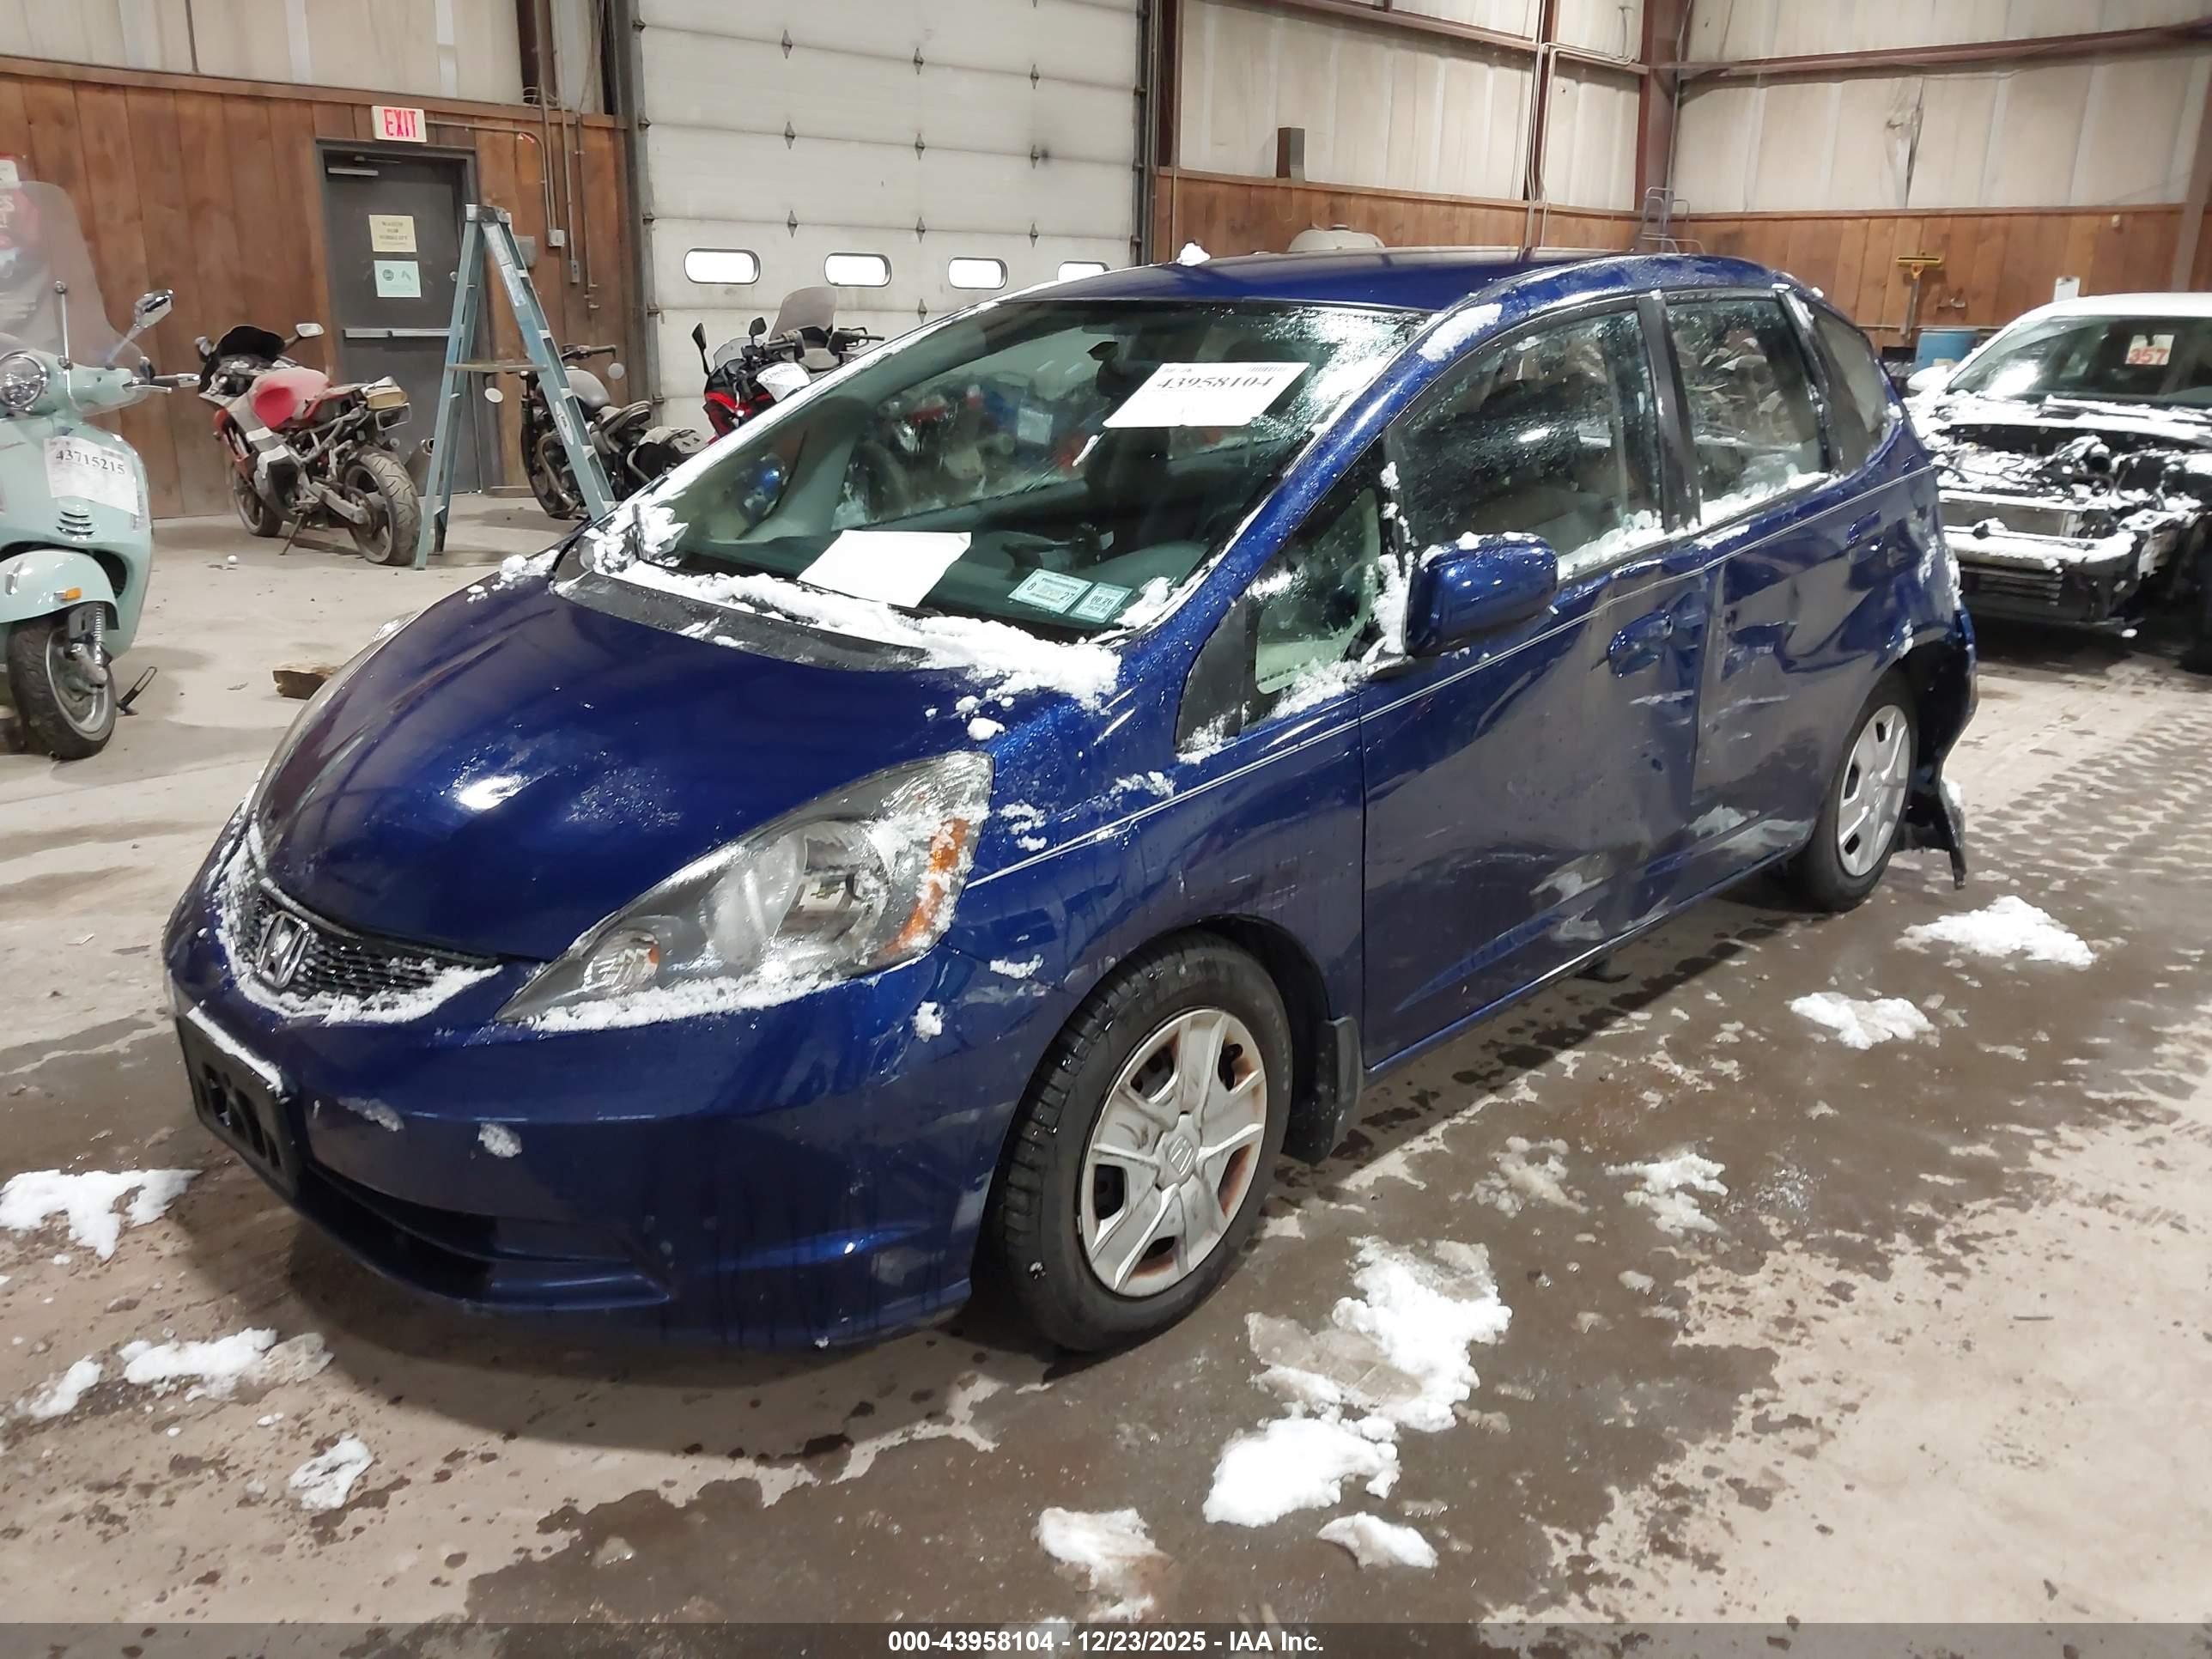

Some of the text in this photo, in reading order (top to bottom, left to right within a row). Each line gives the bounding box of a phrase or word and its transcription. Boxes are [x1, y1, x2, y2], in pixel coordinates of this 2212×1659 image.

[384, 109, 416, 137] EXIT
[1157, 376, 1274, 389] 43958104
[56, 449, 125, 474] 43715215
